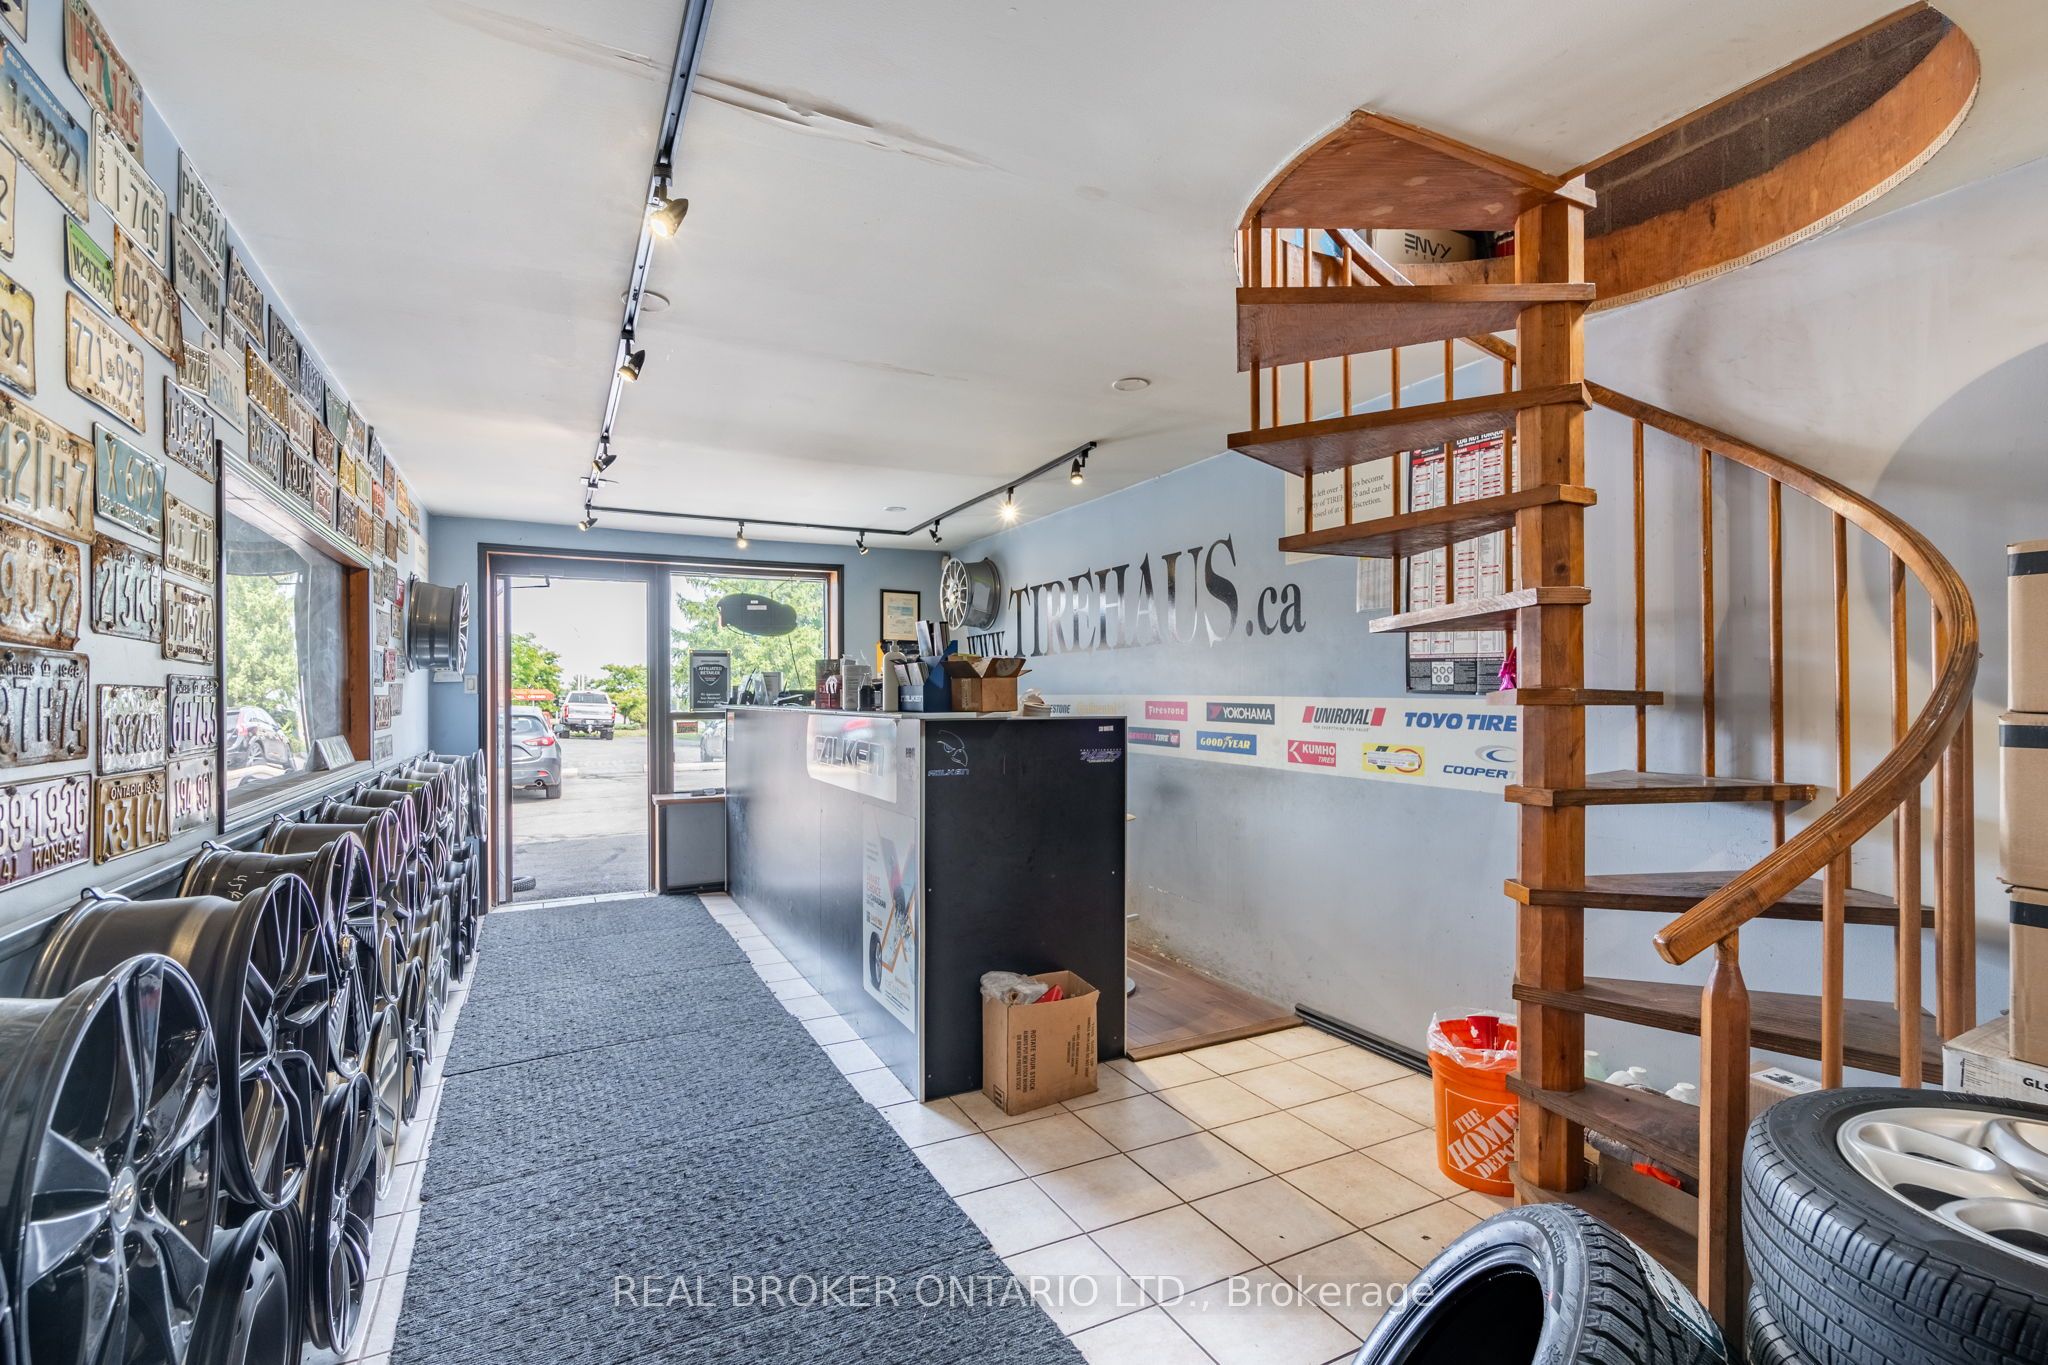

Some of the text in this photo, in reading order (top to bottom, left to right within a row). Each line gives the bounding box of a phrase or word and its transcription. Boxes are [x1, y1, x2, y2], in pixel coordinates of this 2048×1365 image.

[1361, 474, 1384, 486] become
[1359, 487, 1370, 497] and
[1148, 705, 1185, 717] Firestone
[1223, 707, 1273, 721] YOKOHAMA
[1313, 707, 1371, 726] UNIROYAL
[1404, 711, 1463, 730] TOYO
[1302, 743, 1336, 755] KUMHO
[1318, 756, 1335, 764] TIRES
[1443, 764, 1508, 779] COOPER
[111, 779, 159, 800] ONTARIO 1933
[33, 836, 81, 872] KANSAS
[1453, 1108, 1485, 1134] THE
[1551, 1232, 1567, 1265] GEN2
